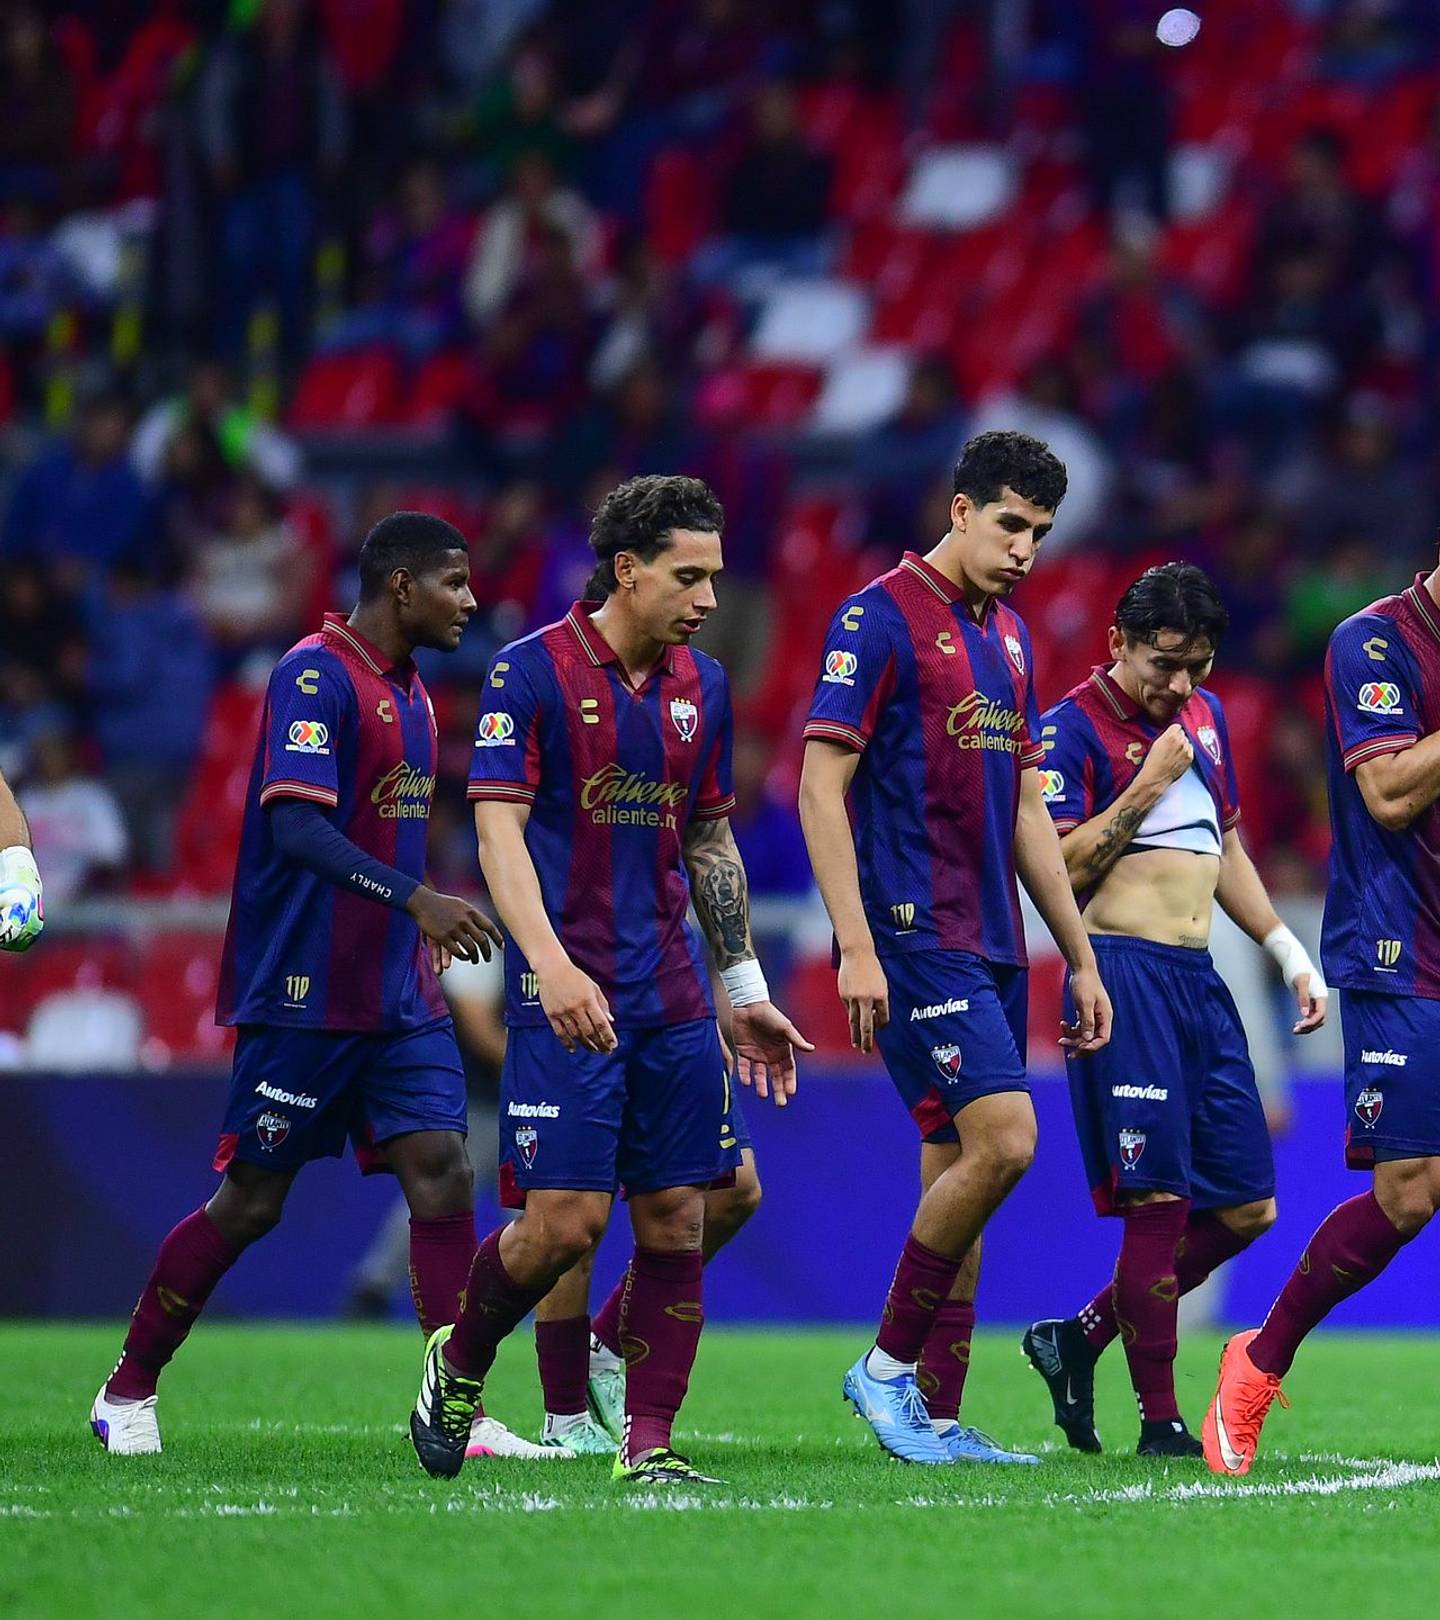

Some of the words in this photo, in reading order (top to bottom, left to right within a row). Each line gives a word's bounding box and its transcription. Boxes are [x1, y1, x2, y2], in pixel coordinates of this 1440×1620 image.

[349, 872, 393, 899] CHARLY
[1376, 939, 1402, 967] 110
[285, 974, 310, 1002] 110
[909, 998, 969, 1023] Autovías
[254, 1080, 319, 1109] Autovías
[1111, 1083, 1168, 1101] utovías
